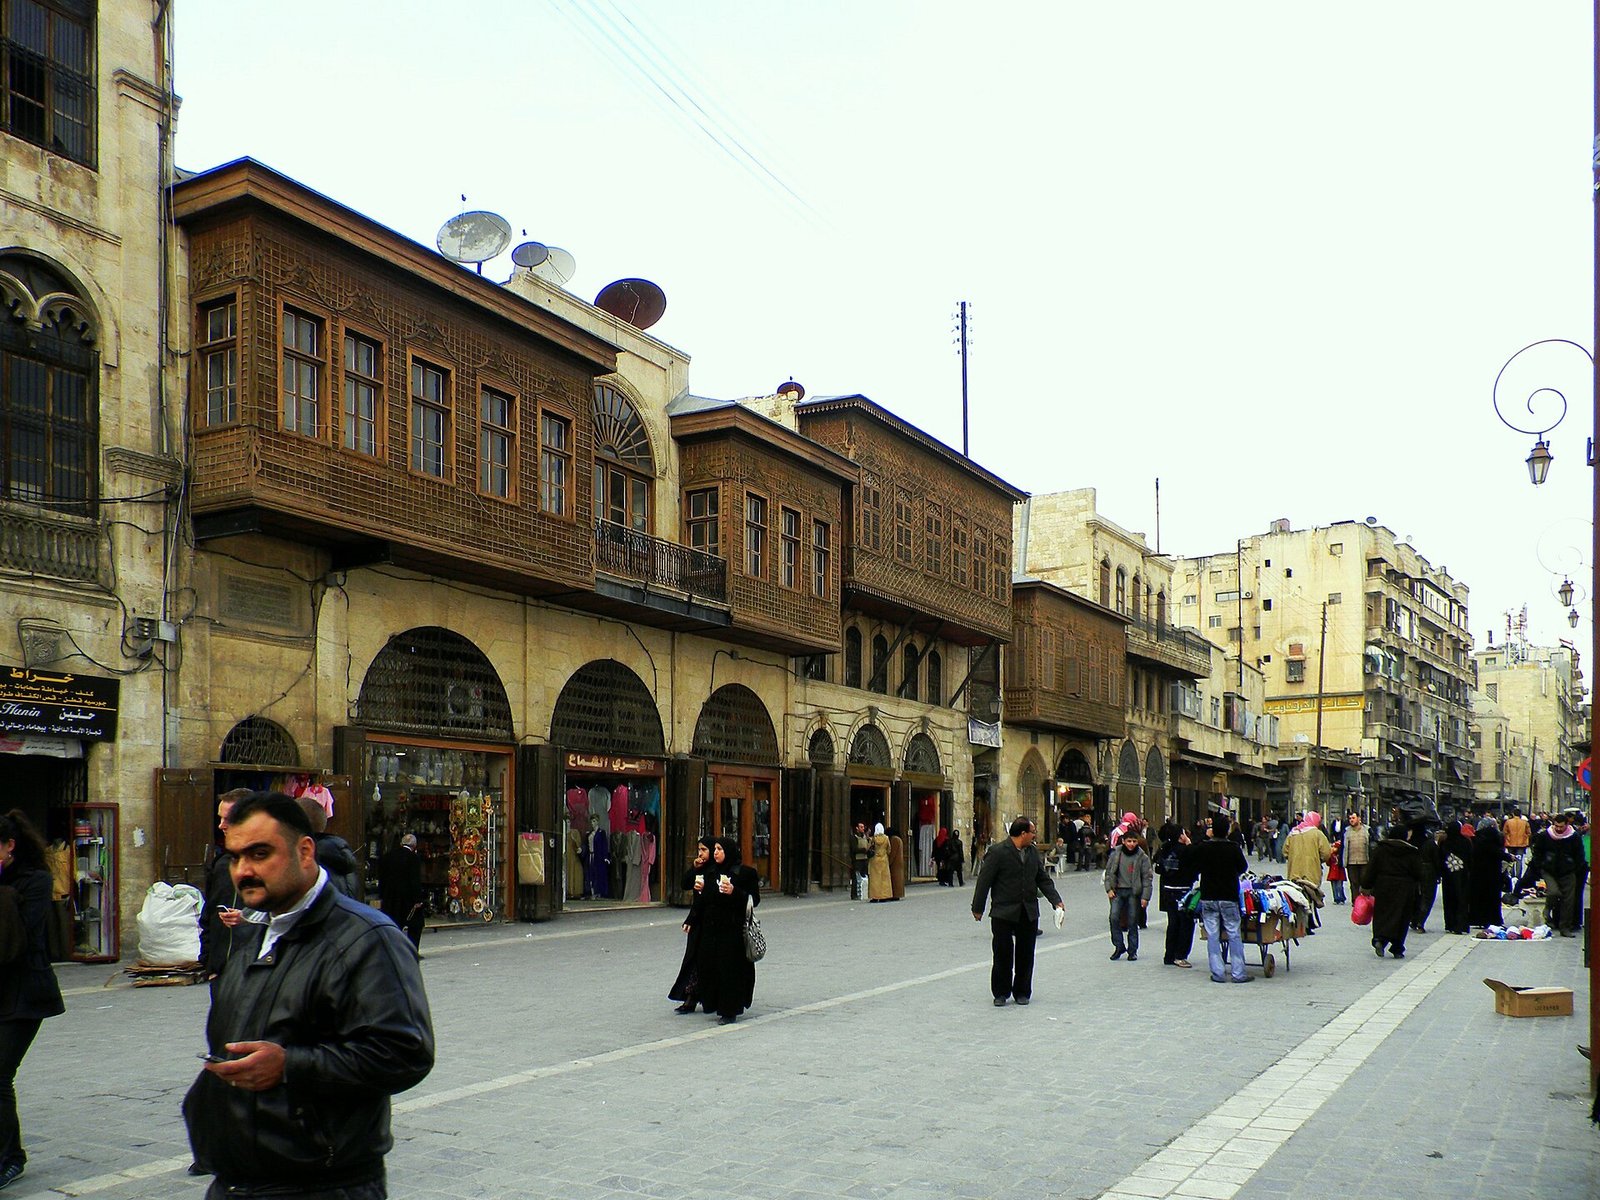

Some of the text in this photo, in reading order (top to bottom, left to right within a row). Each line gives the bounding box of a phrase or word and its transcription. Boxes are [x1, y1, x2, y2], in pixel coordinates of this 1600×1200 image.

[10, 668, 75, 684] خراط
[59, 708, 96, 722] حنين
[568, 753, 609, 768] الشماع
